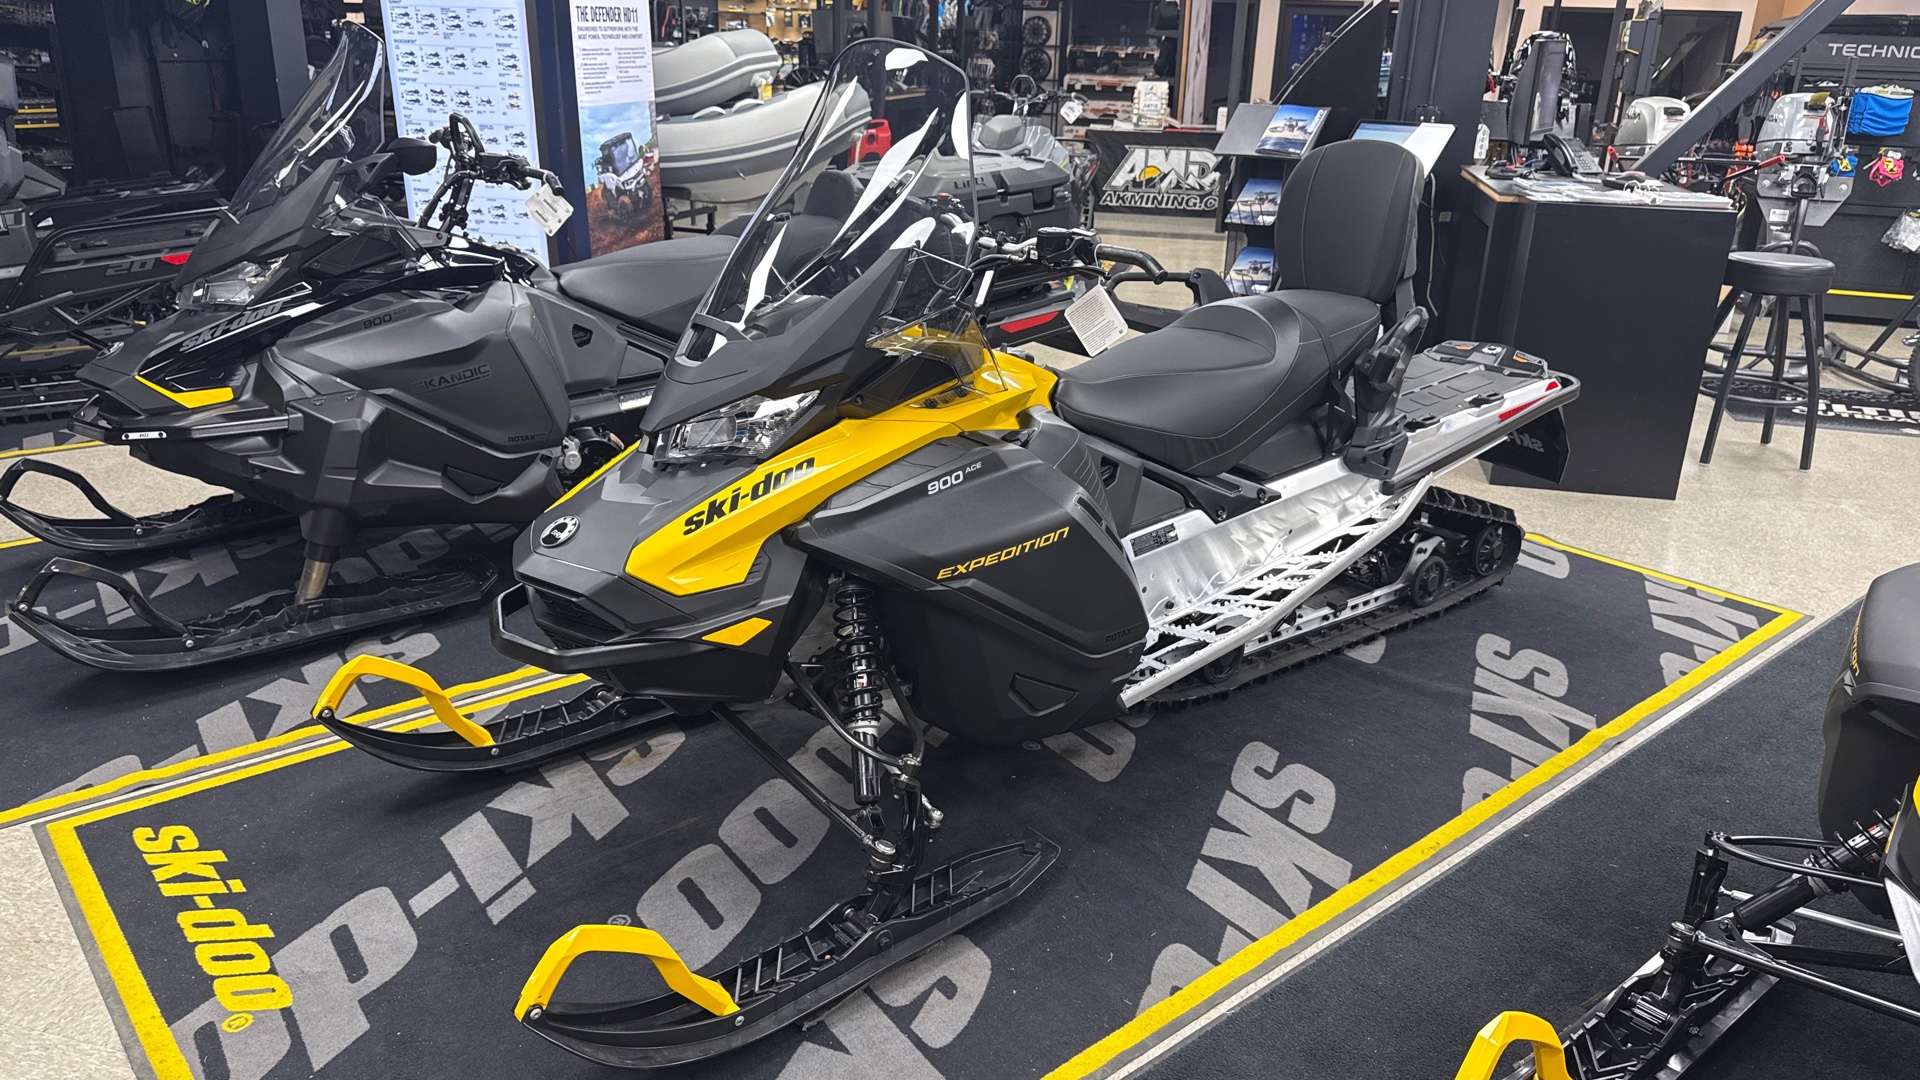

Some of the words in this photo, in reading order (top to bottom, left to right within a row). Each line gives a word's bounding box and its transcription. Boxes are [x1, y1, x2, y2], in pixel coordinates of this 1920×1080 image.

[576, 6, 589, 22] THE
[591, 6, 622, 22] DEFENDER
[623, 7, 639, 23] HD11
[106, 258, 156, 276] 20
[362, 313, 393, 330] 900
[507, 434, 536, 443] ROTAX
[927, 470, 964, 495] 900
[964, 461, 982, 474] ACE
[683, 456, 815, 536] ski-doo
[936, 526, 1069, 580] EXPEDITION
[1105, 626, 1134, 644] ROTAX
